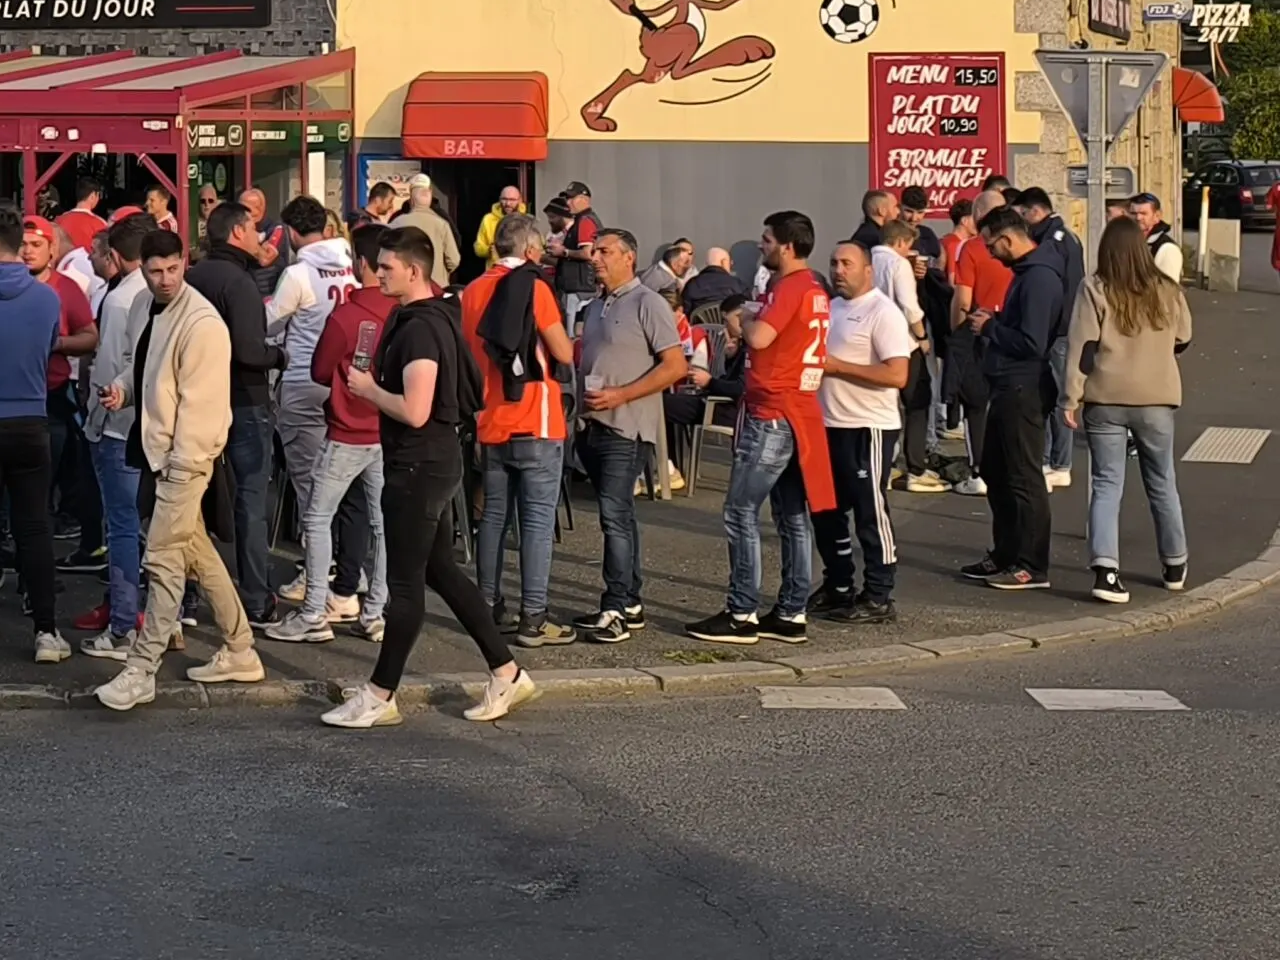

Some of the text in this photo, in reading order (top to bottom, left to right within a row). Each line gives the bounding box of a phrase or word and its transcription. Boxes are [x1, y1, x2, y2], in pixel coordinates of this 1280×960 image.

[1149, 4, 1170, 15] FDJ
[1190, 2, 1252, 27] PIZZA
[1198, 26, 1239, 43] 24/7
[886, 63, 998, 86] MENU 15,50
[891, 94, 981, 116] PLAT DU
[886, 114, 979, 137] JOUR 10,90
[444, 139, 485, 156] BAR
[887, 147, 988, 169] FORMULE
[883, 167, 993, 188] SANDWICH
